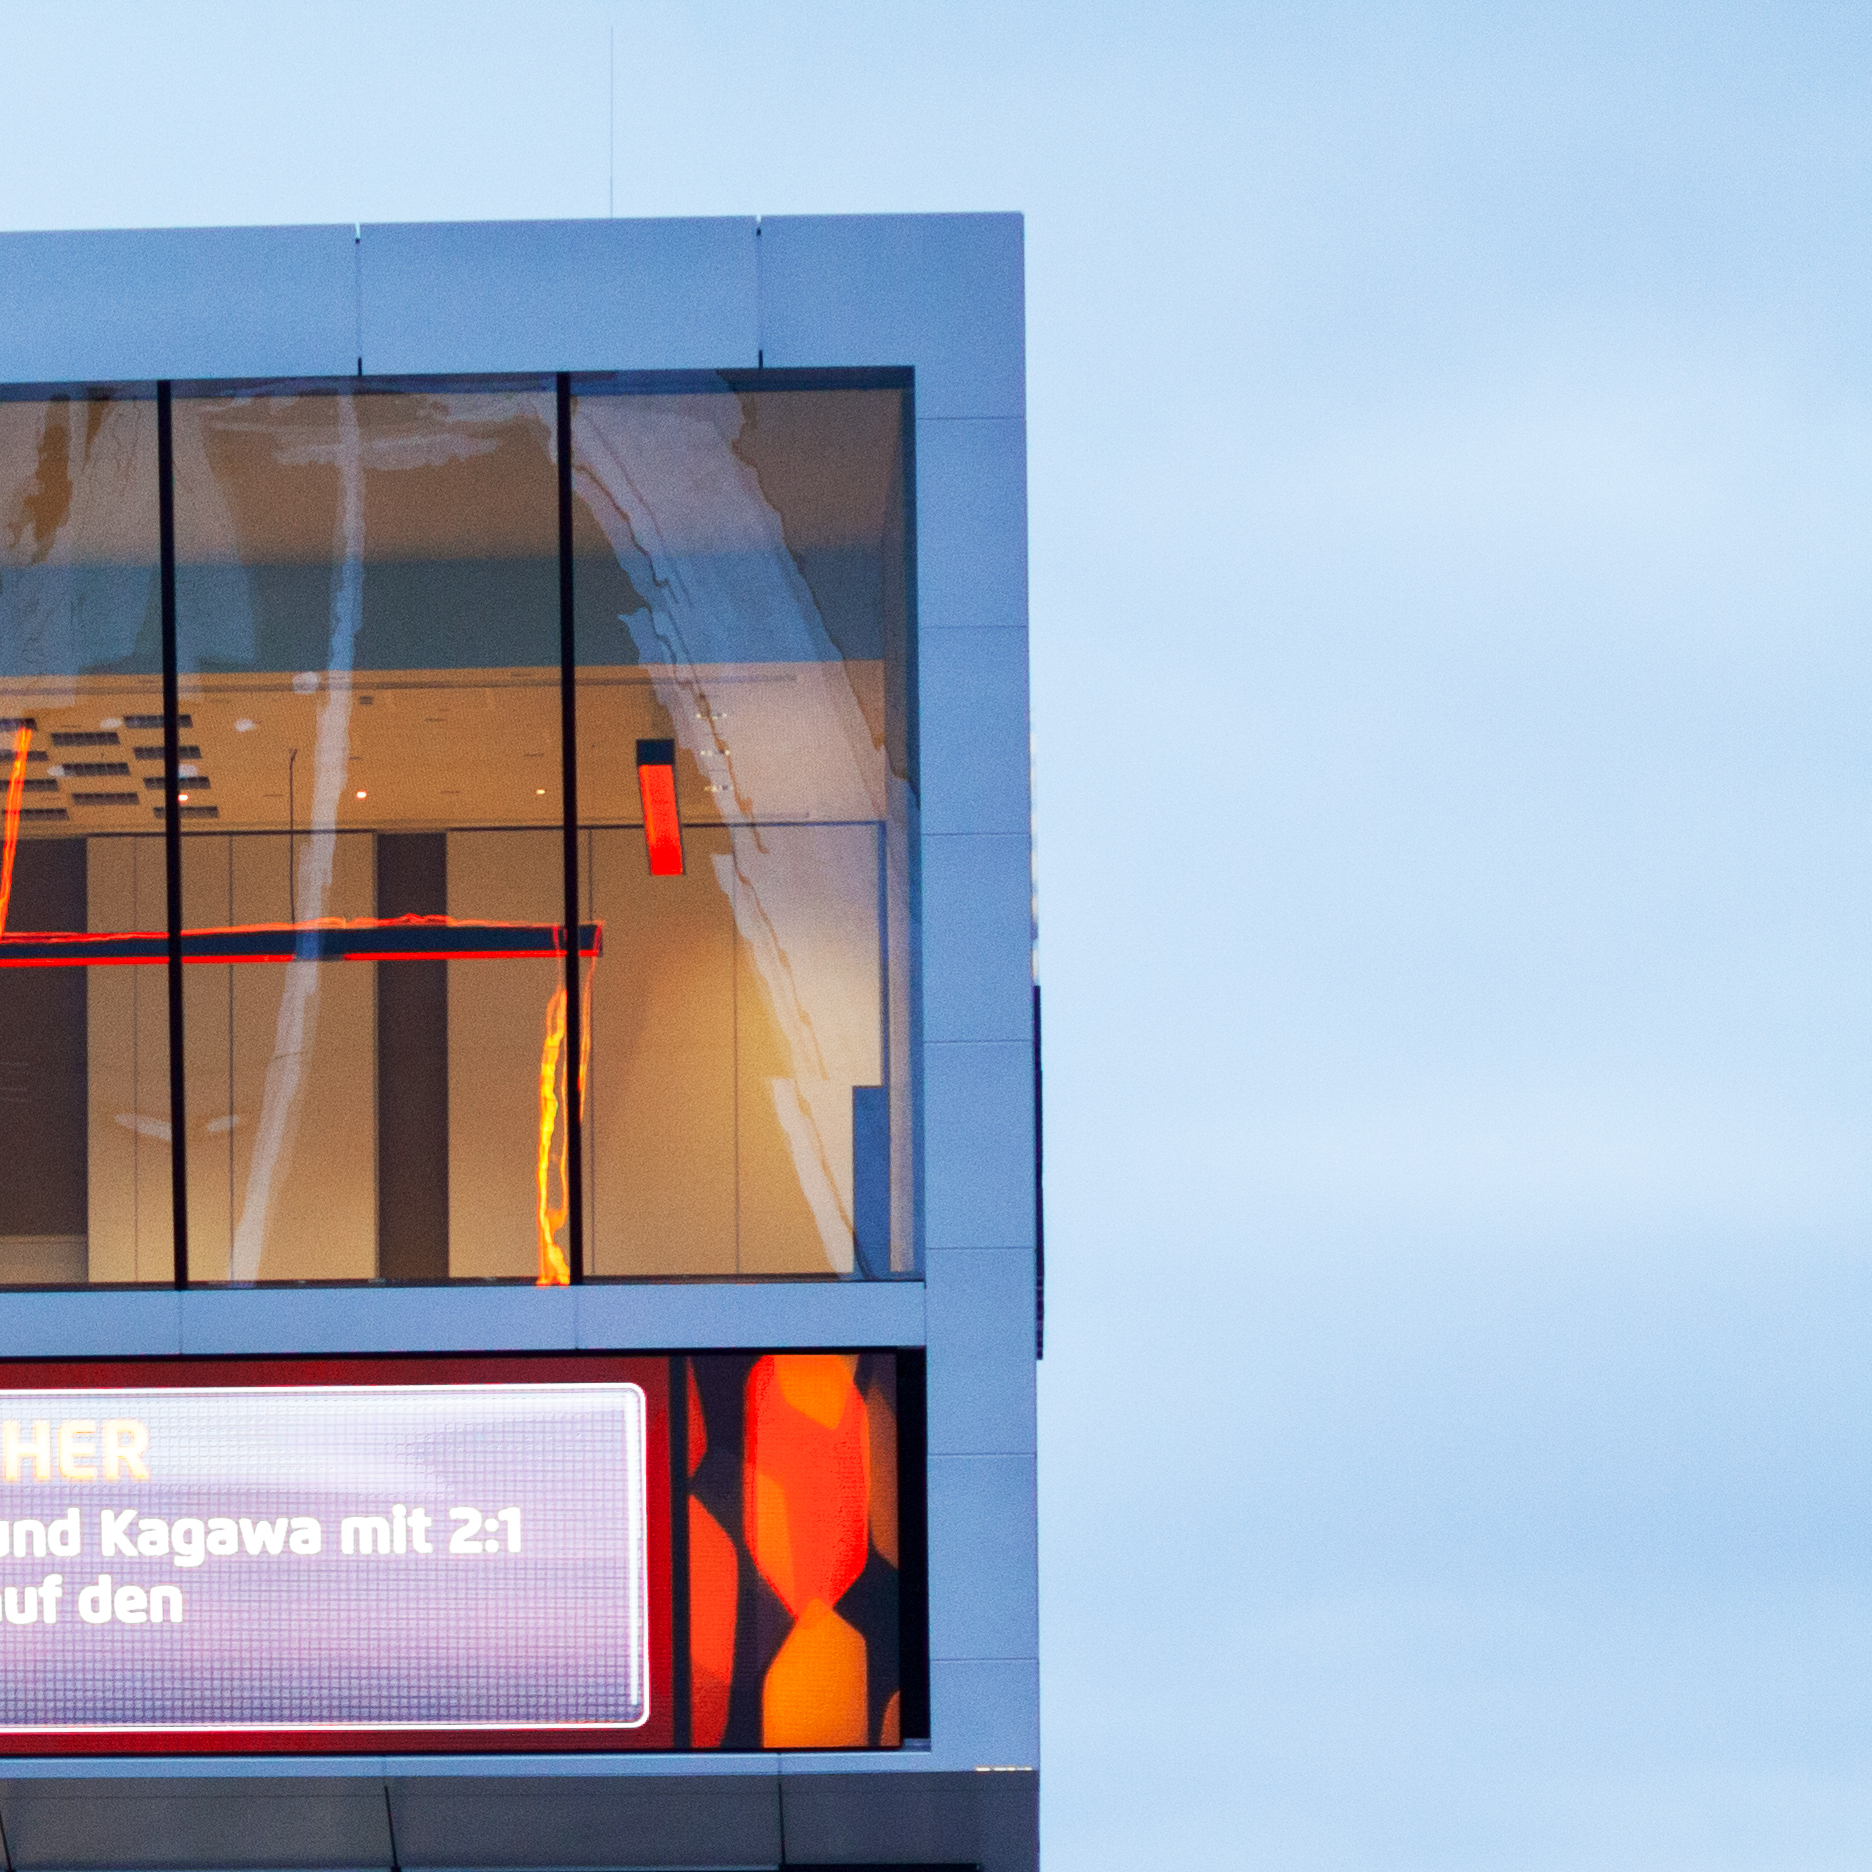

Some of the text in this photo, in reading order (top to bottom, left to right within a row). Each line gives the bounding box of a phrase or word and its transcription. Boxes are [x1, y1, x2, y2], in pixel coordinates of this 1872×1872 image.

[100, 1508, 322, 1566] Kagawa
[340, 1503, 433, 1555] mit
[449, 1505, 523, 1555] 2:1
[78, 1573, 184, 1622] den
